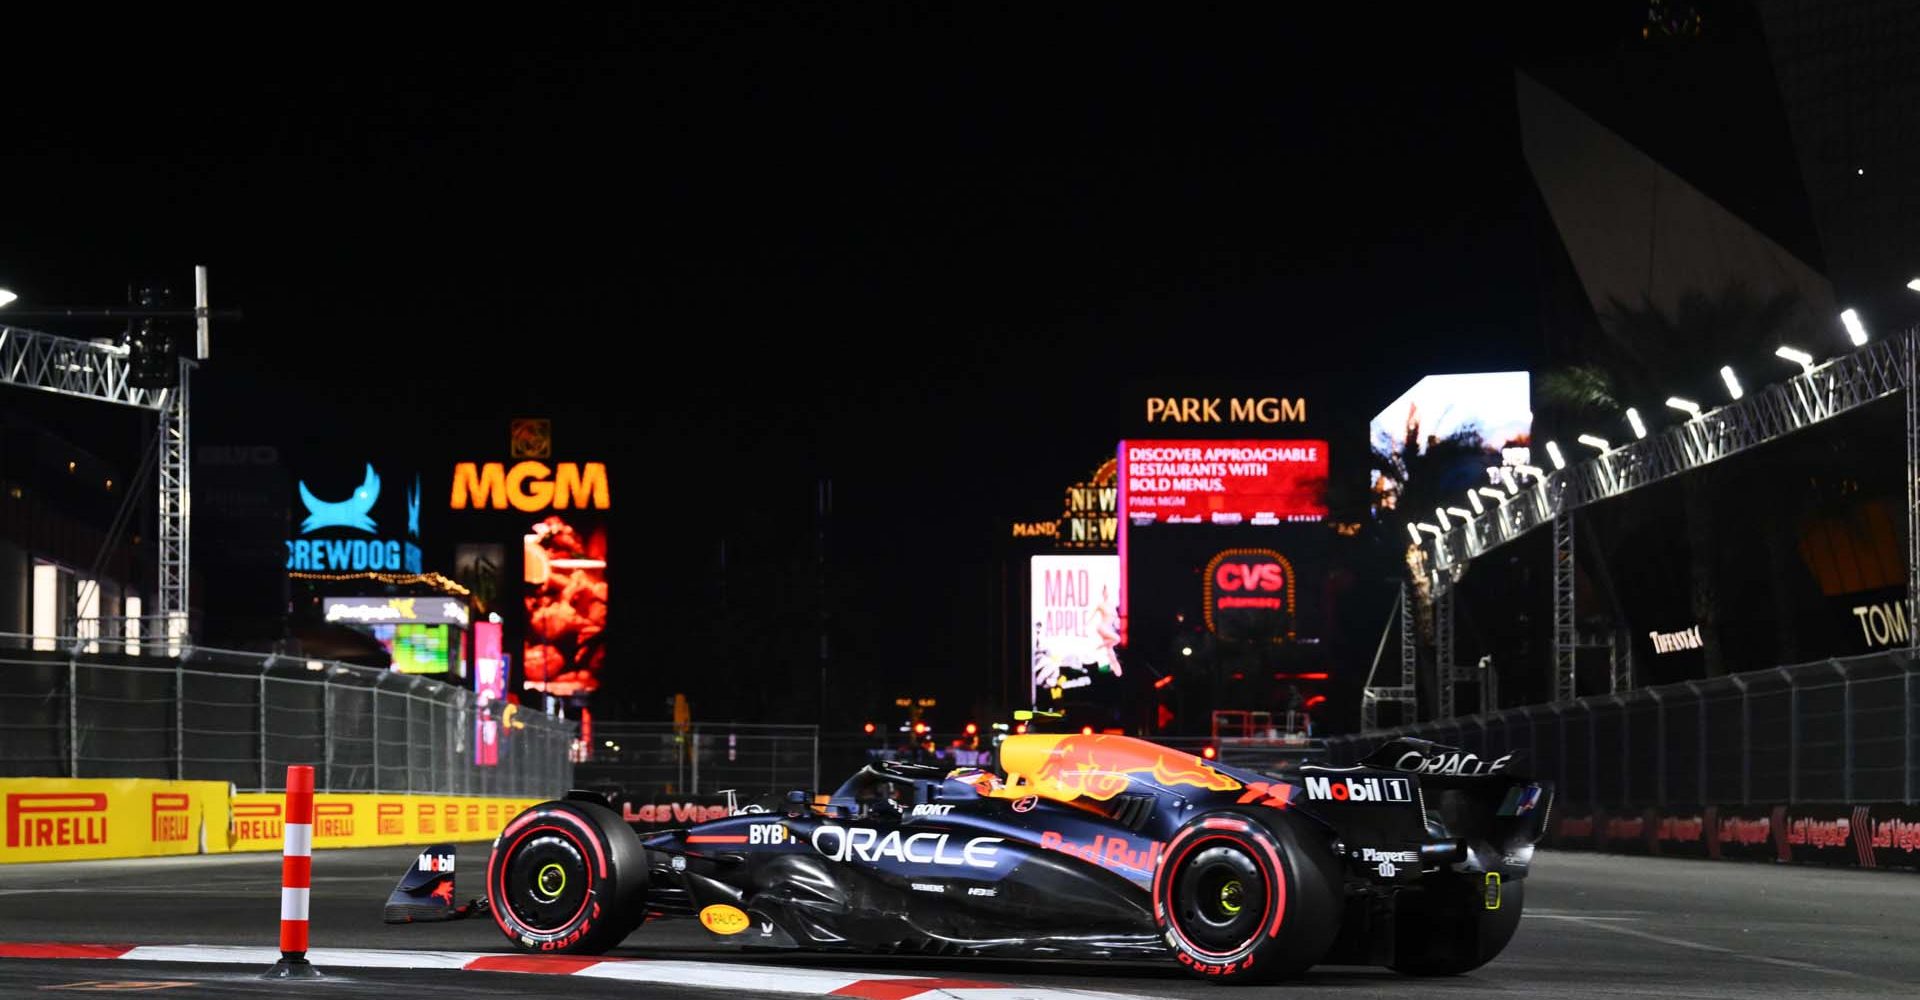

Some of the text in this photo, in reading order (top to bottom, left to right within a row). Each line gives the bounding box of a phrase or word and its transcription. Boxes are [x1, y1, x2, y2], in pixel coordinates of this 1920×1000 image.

[1147, 397, 1306, 423] PARK MGM
[1130, 448, 1317, 462] DISCOVER APPROACHABLE
[1130, 463, 1268, 476] RESTAURANTS WITH
[450, 460, 611, 513] MGM
[1071, 487, 1117, 512] NEW
[1130, 478, 1225, 492] BOLD MENUS.
[1071, 518, 1118, 541] NEW
[1045, 569, 1089, 607] MAD
[1216, 562, 1283, 592] CVS
[1045, 610, 1089, 638] APPLE
[1853, 601, 1909, 647] TOM
[1305, 776, 1382, 802] Mobil
[6, 792, 108, 848] PIRELLI
[152, 793, 189, 842] PIRELLI
[234, 803, 283, 841] PIRELLI
[314, 803, 354, 837] PIRELLI
[811, 825, 1005, 868] ORACLE
[1040, 831, 1104, 866] Red
[1362, 848, 1406, 863] Player
[418, 854, 455, 872] Mobil
[541, 918, 592, 951] ZERO
[1177, 952, 1237, 975] ZERO
